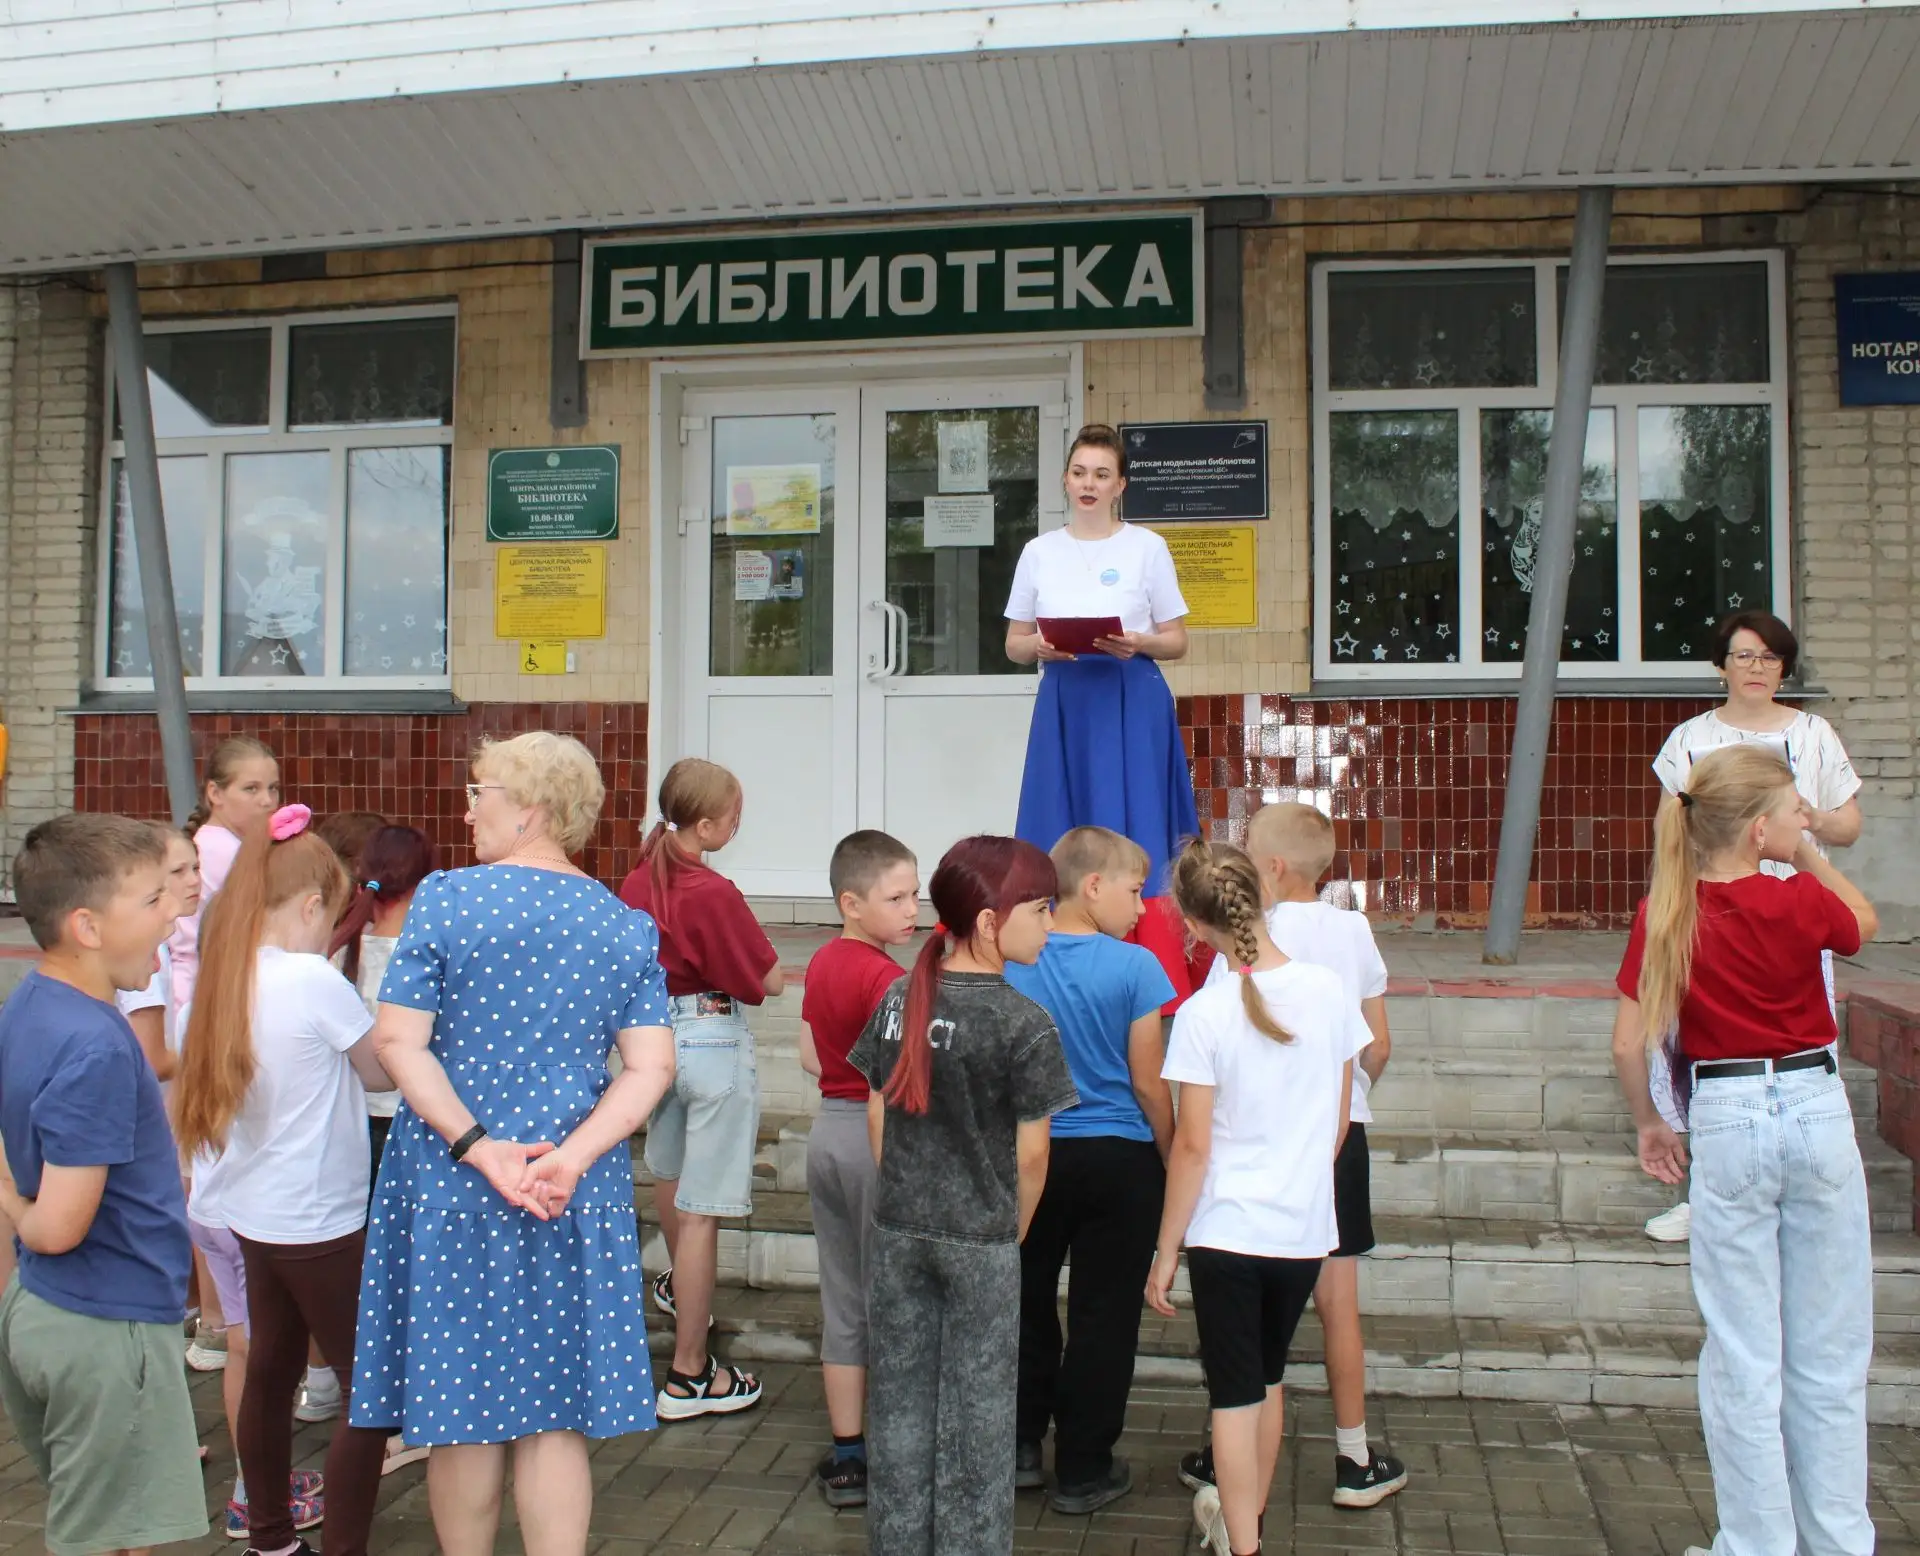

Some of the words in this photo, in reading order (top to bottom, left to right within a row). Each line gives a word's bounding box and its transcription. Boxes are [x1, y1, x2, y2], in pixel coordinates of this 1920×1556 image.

[608, 242, 1174, 329] БИБЛИОТЕКА
[1852, 342, 1920, 358] НОТАР
[1129, 460, 1162, 469] Детская
[1163, 459, 1207, 468] модельная
[1208, 457, 1256, 465] библиотека
[509, 484, 558, 493] ЦЕНТРАЛЬНАЯ
[559, 483, 597, 491] РАЙОННАЯ
[517, 493, 588, 504] БИБЛИОТЕКА
[1187, 541, 1233, 549] МОДЕЛЬНАЯ
